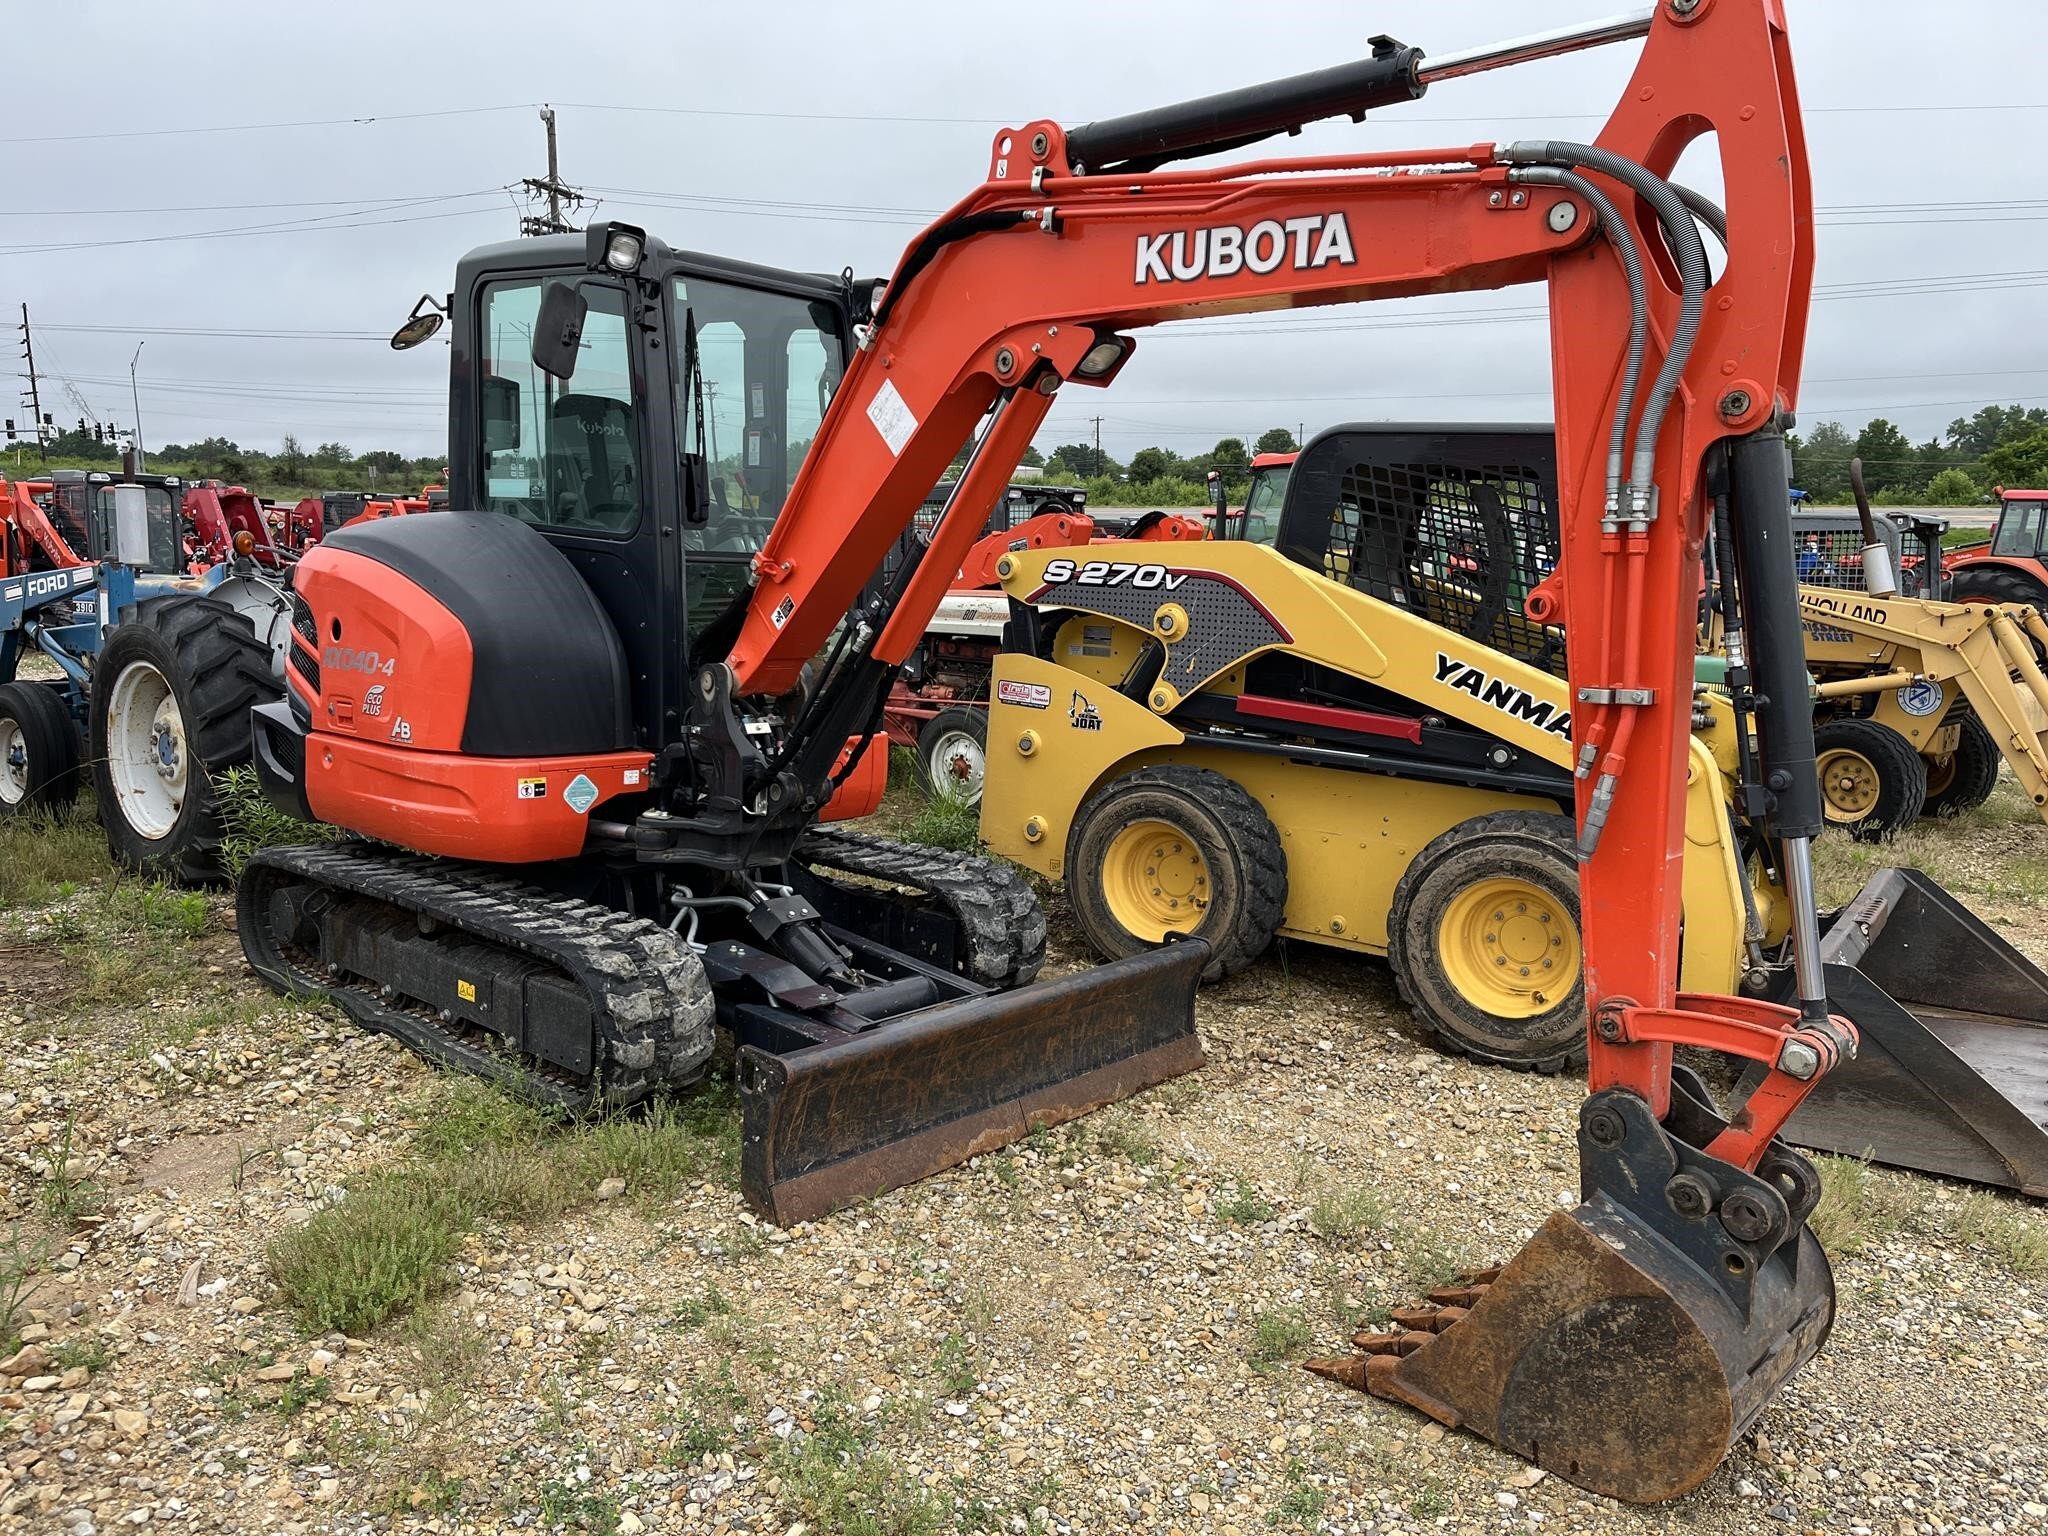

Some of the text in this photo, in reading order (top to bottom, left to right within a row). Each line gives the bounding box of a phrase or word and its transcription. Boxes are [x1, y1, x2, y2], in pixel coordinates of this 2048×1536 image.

[1134, 213, 1356, 284] KUBOTA
[577, 420, 625, 436] Kubota
[27, 573, 68, 597] FORD
[75, 603, 94, 613] 3910
[1804, 595, 1887, 625] HOLLAND
[1812, 632, 1854, 643] STREET
[366, 693, 382, 705] eco
[362, 704, 381, 716] PLUS
[1071, 719, 1102, 730] JOAT
